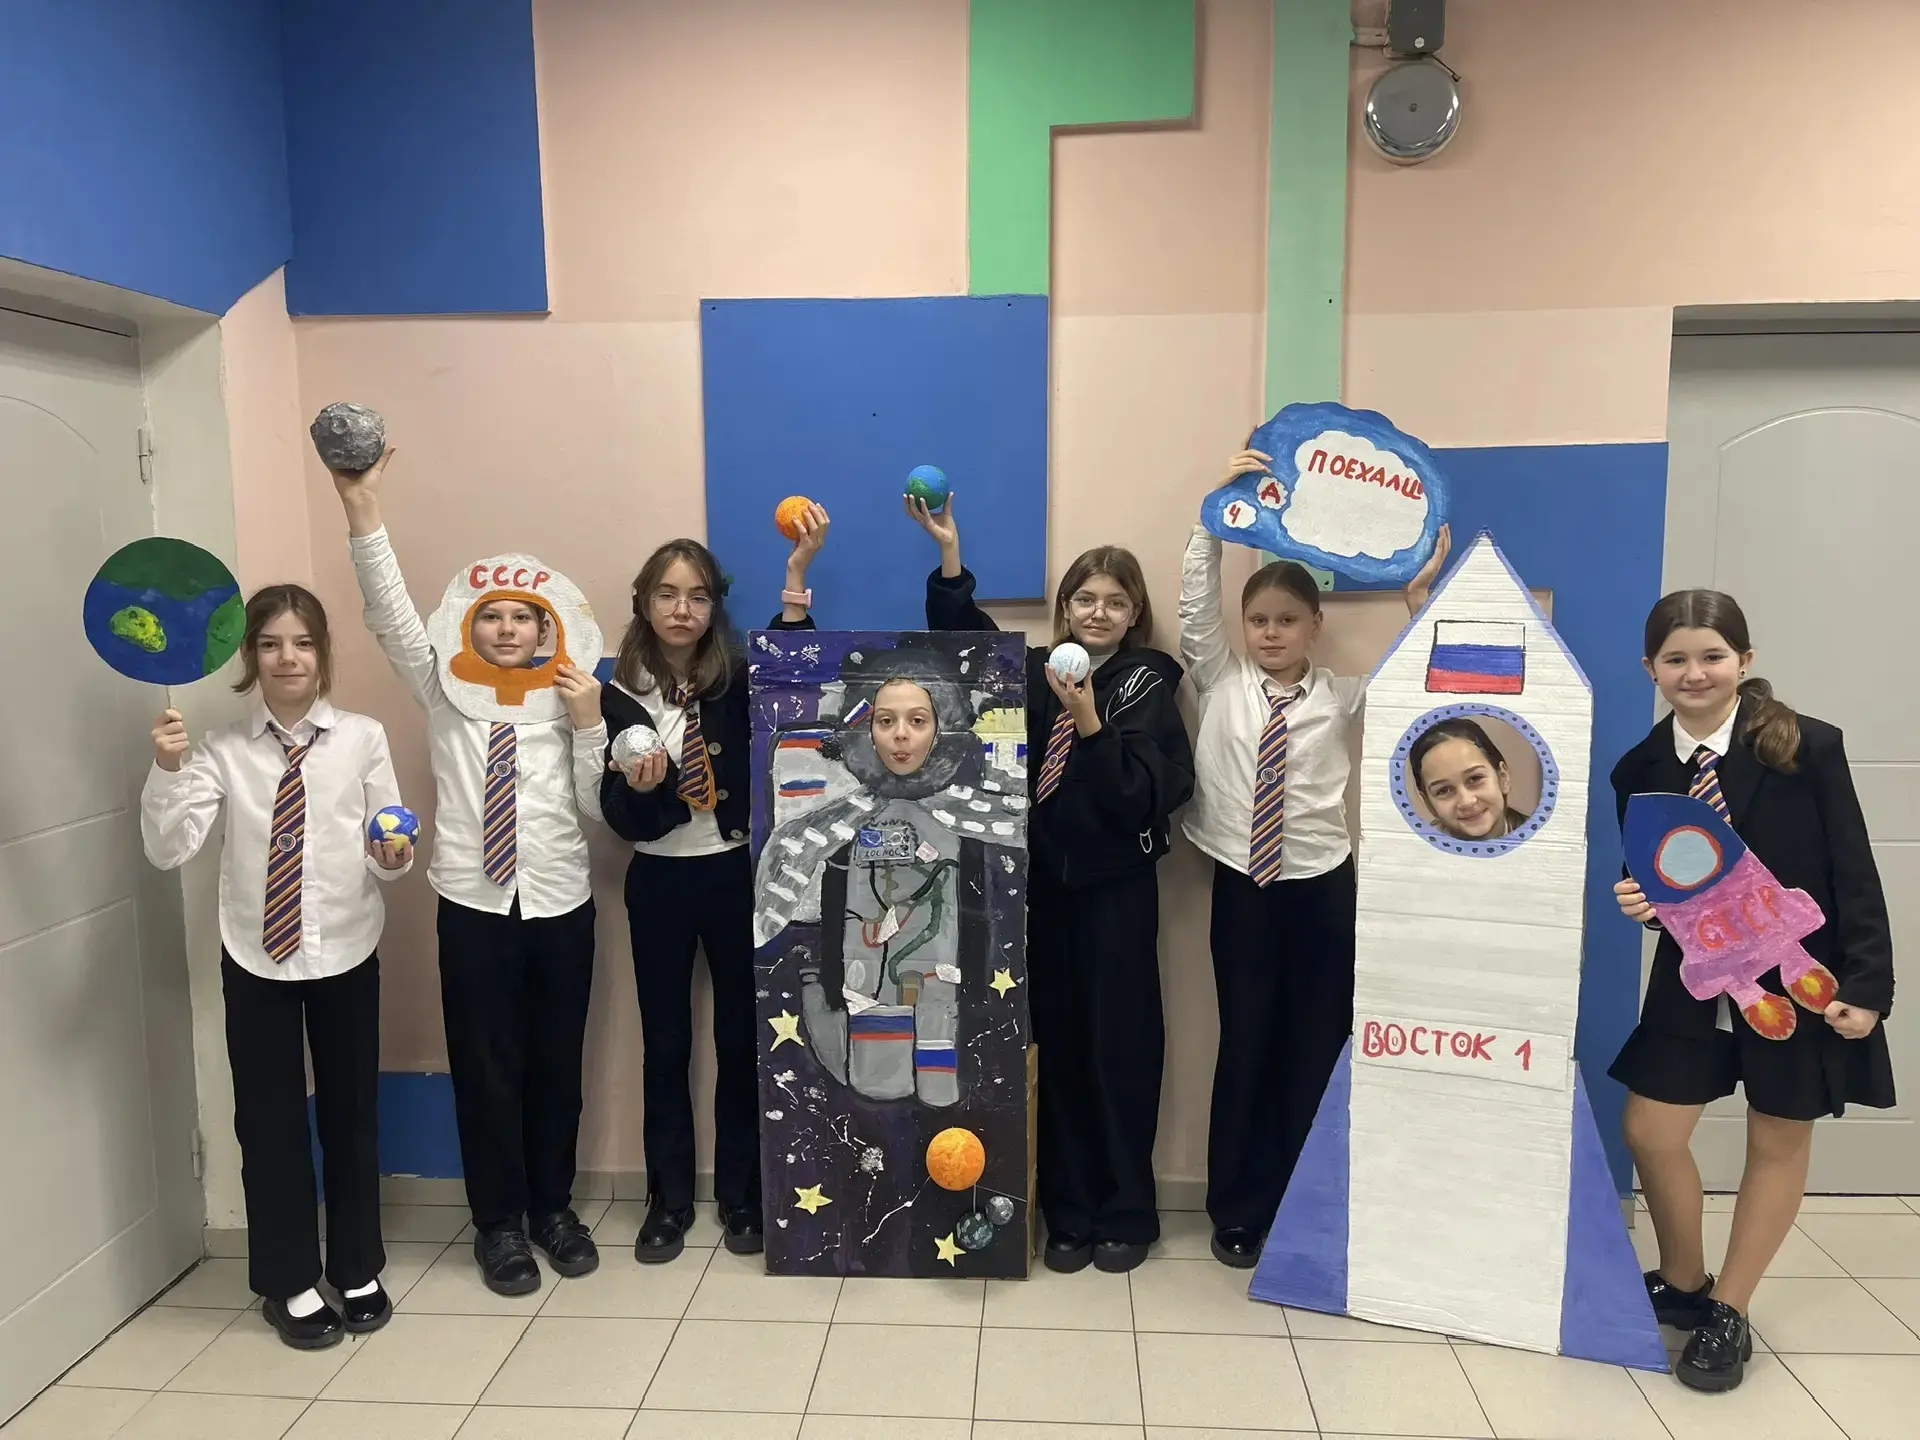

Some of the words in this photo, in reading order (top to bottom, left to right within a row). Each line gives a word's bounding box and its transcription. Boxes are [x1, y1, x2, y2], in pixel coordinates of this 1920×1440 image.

[469, 564, 551, 590] СССР
[1361, 1021, 1497, 1062] ВОСТОК
[1513, 1038, 1533, 1071] 1
